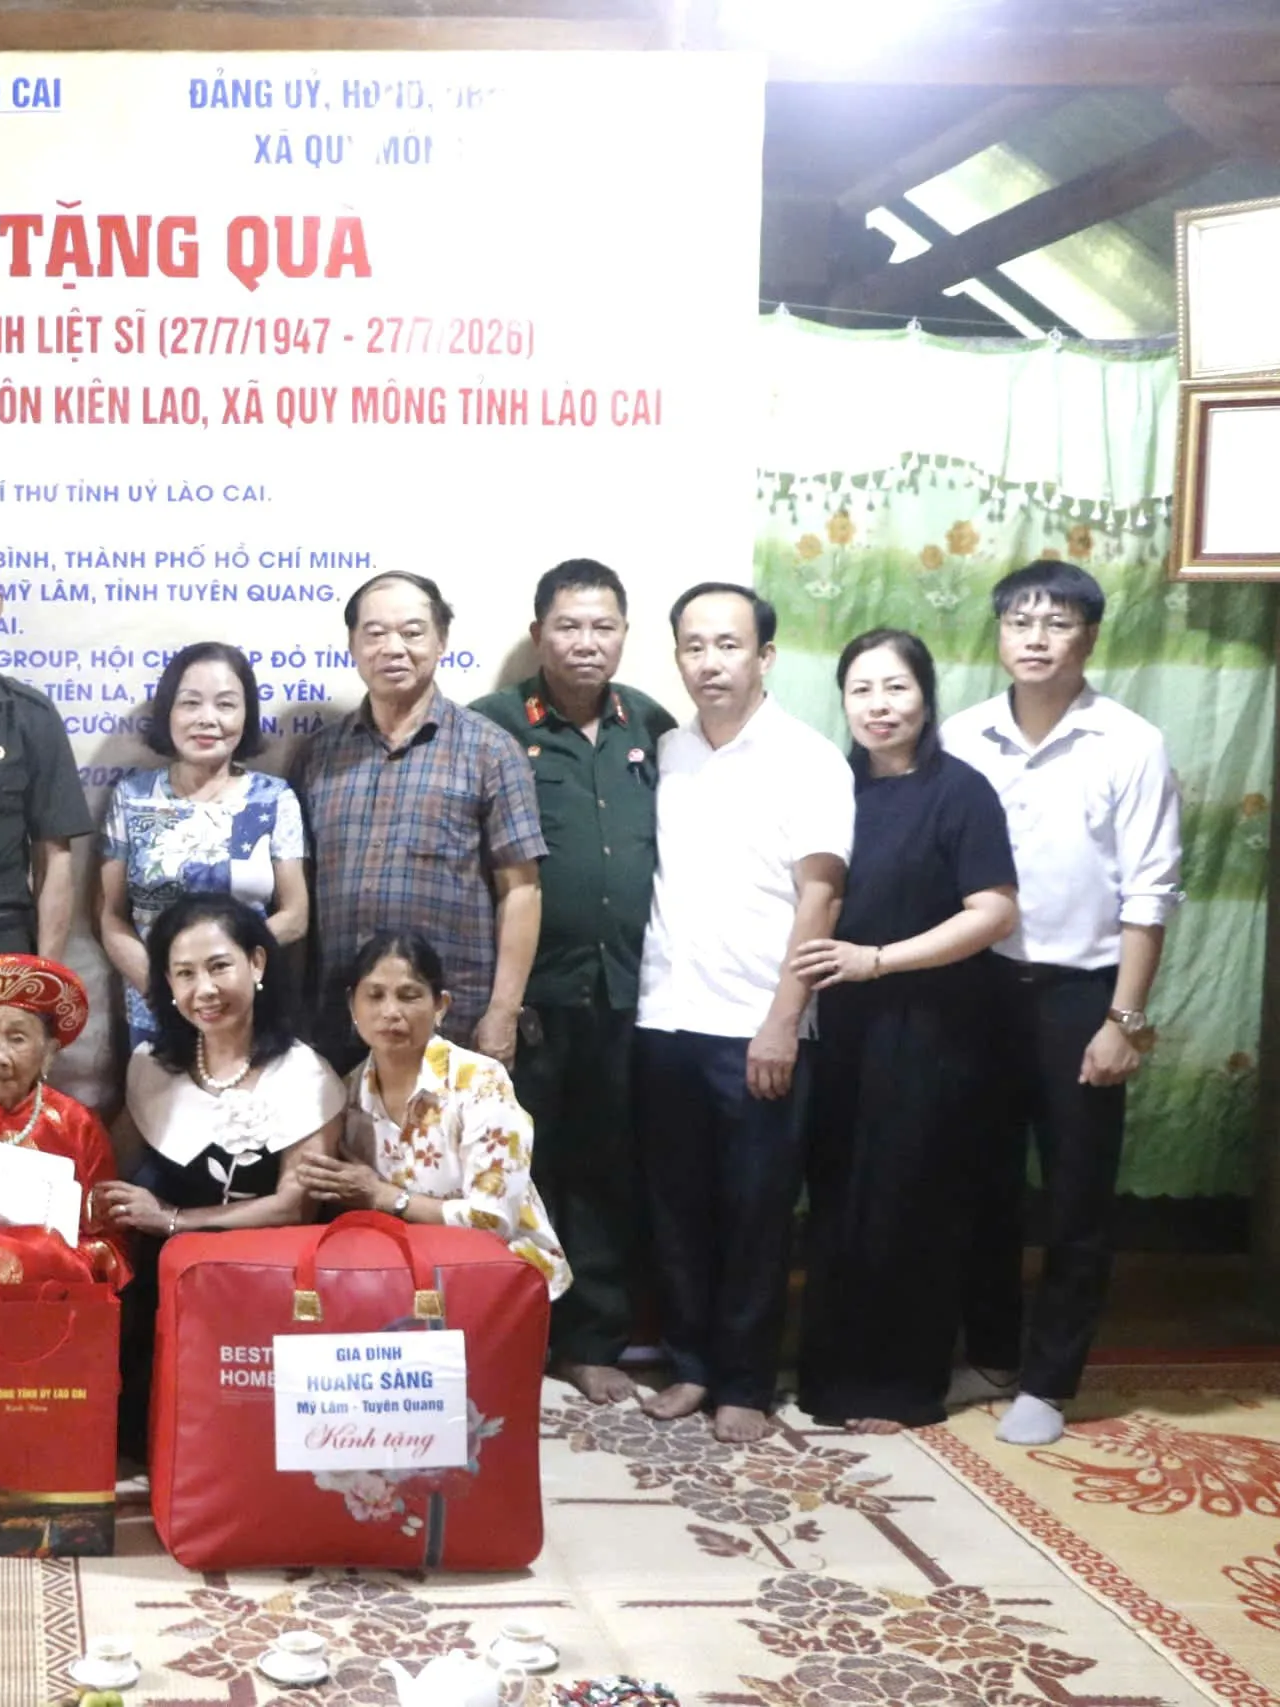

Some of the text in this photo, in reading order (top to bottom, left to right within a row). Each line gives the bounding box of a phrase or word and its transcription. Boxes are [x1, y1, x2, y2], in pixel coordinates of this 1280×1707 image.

[12, 78, 61, 110] CAI
[189, 67, 272, 109] ĐẢNG
[227, 203, 372, 292] QUÀ
[37, 307, 103, 362] LIỆT
[114, 308, 147, 355] SĨ
[159, 316, 331, 359] (27/7/1947
[367, 317, 535, 360] 27/7/2026)
[54, 377, 130, 425] KIÊN
[142, 386, 208, 430] LAO,
[221, 379, 264, 425] XÃ
[276, 386, 338, 429] QUY
[352, 378, 446, 425] MÔNG
[458, 374, 528, 427] TỈNH
[541, 381, 597, 427] LÀO
[611, 389, 662, 427] CAI
[14, 482, 59, 502] THƯ
[66, 478, 119, 503] TỈNH
[129, 478, 158, 503] UỶ
[167, 480, 214, 503] LÀO
[223, 485, 272, 503] CAI.
[64, 546, 146, 568] THÀNH
[155, 544, 206, 569] PHỐ
[214, 542, 250, 568] HỒ
[258, 546, 302, 568] CHÍ
[310, 551, 377, 569] MINH.
[0, 577, 342, 605] MỸ LÂM, TỈNH TUYÊN QUANG.
[91, 646, 135, 674] HỘI
[270, 644, 307, 668] ĐỎ
[45, 679, 92, 701] TIÊN
[102, 684, 135, 704] LA,
[283, 679, 332, 701] YÊN.
[220, 1345, 273, 1364] BEST
[336, 1345, 402, 1361] GIA ĐÌNH
[380, 1368, 433, 1390] SÀNG
[321, 1400, 348, 1414] Lâm
[362, 1399, 399, 1415] Tuyên
[403, 1398, 444, 1414] Quang
